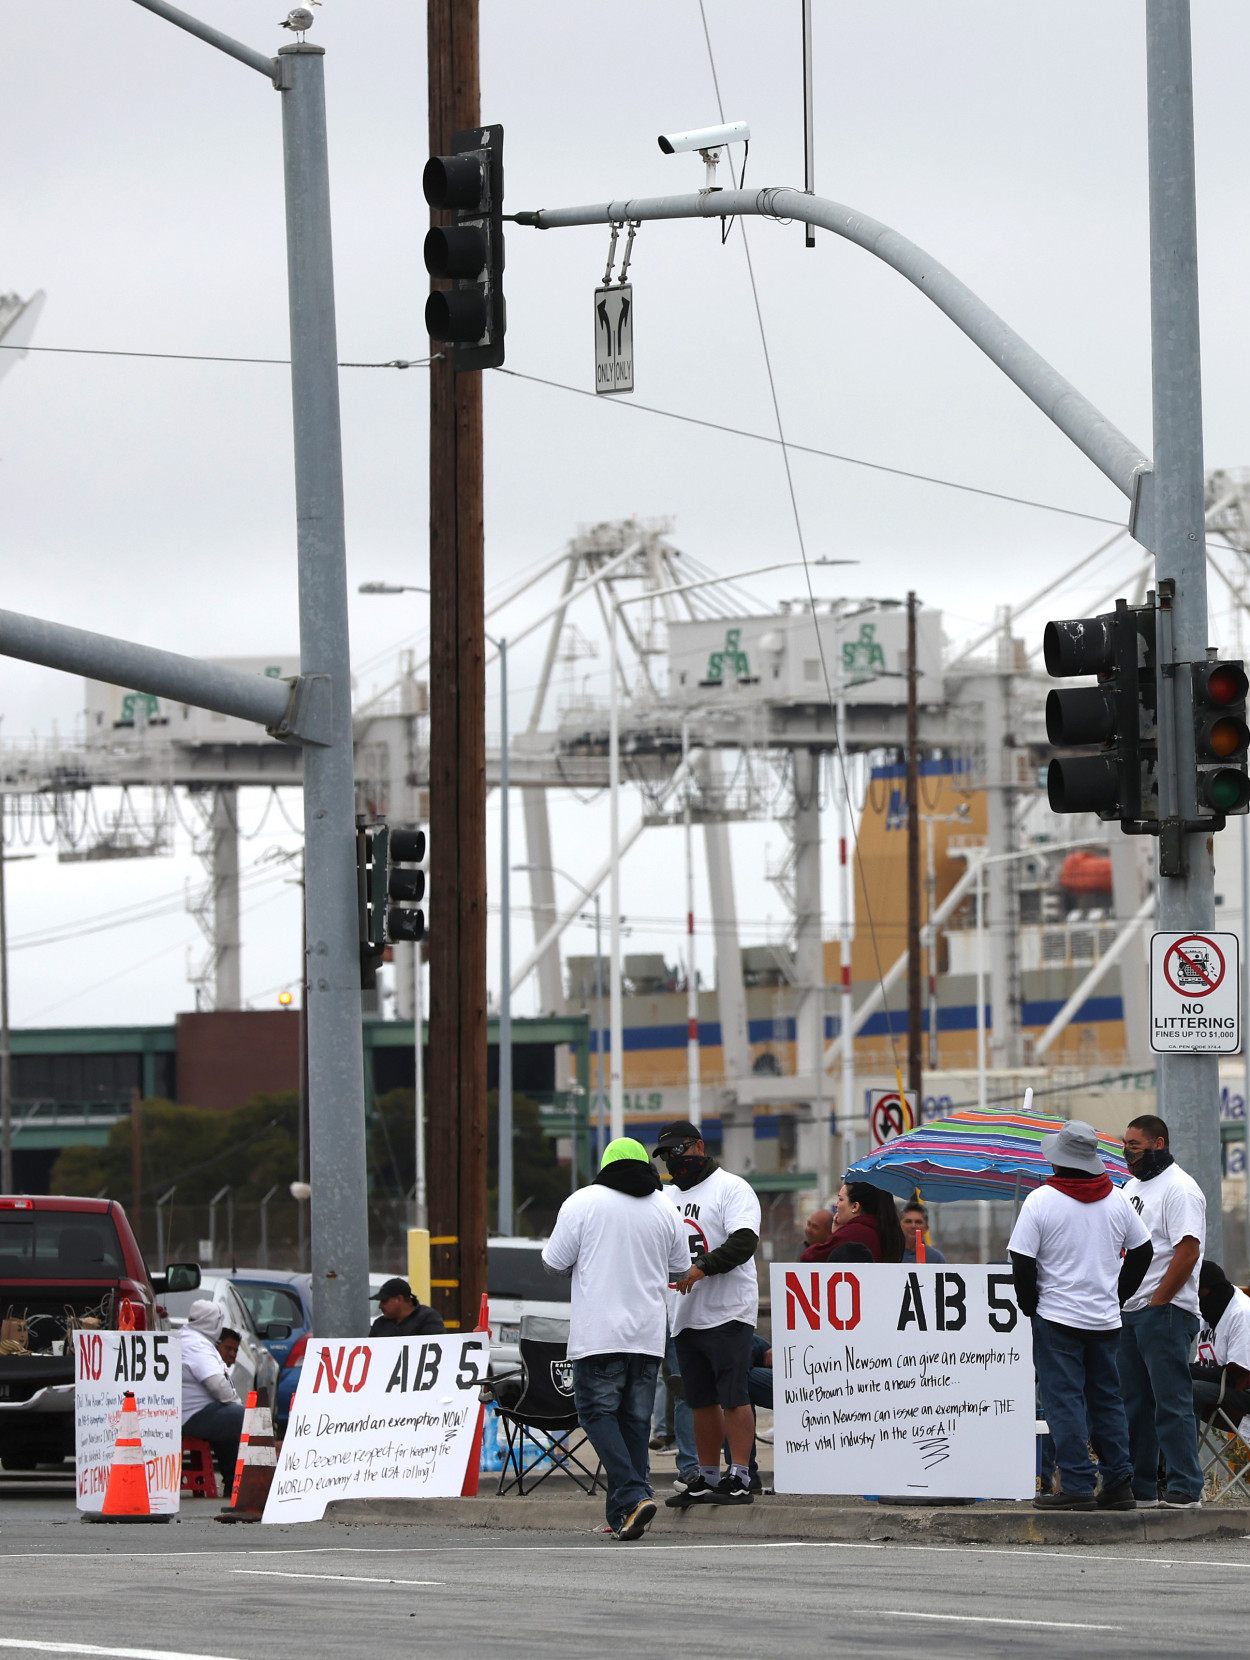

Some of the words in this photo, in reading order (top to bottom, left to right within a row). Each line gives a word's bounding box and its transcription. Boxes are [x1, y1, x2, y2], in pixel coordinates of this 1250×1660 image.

[598, 364, 614, 383] ONLY
[616, 361, 632, 380] ONLY
[1155, 1018, 1235, 1028] LITTERING
[1181, 1003, 1204, 1014] NO
[1209, 1031, 1234, 1039] $1,000
[684, 1203, 700, 1220] ON
[785, 1272, 861, 1331] NO
[896, 1272, 967, 1332] AB
[987, 1273, 1018, 1333] 5
[80, 1334, 102, 1381] NO
[114, 1335, 147, 1382] AB
[153, 1335, 170, 1382] 5
[313, 1345, 372, 1394] NO
[385, 1342, 442, 1394] AB
[456, 1341, 482, 1390] 5
[784, 1346, 796, 1379] IF
[803, 1345, 842, 1384] Gavin
[845, 1345, 892, 1374] Newsom
[896, 1354, 916, 1370] can
[919, 1354, 940, 1378] give
[942, 1352, 956, 1366] an
[959, 1348, 1006, 1371] exemption
[1007, 1347, 1020, 1366] to
[784, 1386, 814, 1404] Willie
[815, 1386, 844, 1402] Brown
[845, 1380, 854, 1396] to
[857, 1380, 882, 1394] write
[884, 1382, 890, 1391] a
[892, 1376, 916, 1390] news
[294, 1414, 311, 1438] We
[316, 1413, 371, 1437] Demand
[372, 1418, 386, 1430] an
[388, 1412, 440, 1432] exemption
[442, 1407, 469, 1429] NOW!
[802, 1409, 831, 1432] Gavin
[832, 1408, 872, 1426] Newsom
[874, 1409, 890, 1423] can
[892, 1406, 919, 1420] issue
[921, 1404, 934, 1416] an
[935, 1400, 978, 1418] exemption
[978, 1400, 992, 1416] for
[994, 1399, 1015, 1416] THE
[814, 1434, 836, 1451] vital
[840, 1431, 876, 1450] industry
[892, 1426, 908, 1441] the
[926, 1424, 936, 1436] of
[284, 1452, 300, 1472] We
[304, 1449, 350, 1470] Deserve
[353, 1441, 395, 1468] respect
[395, 1443, 407, 1462] for
[438, 1442, 451, 1456] the
[277, 1478, 314, 1496] WORLD
[316, 1473, 352, 1492] economy
[364, 1467, 378, 1482] the
[381, 1466, 400, 1480] USA
[402, 1462, 436, 1484] rolling!
